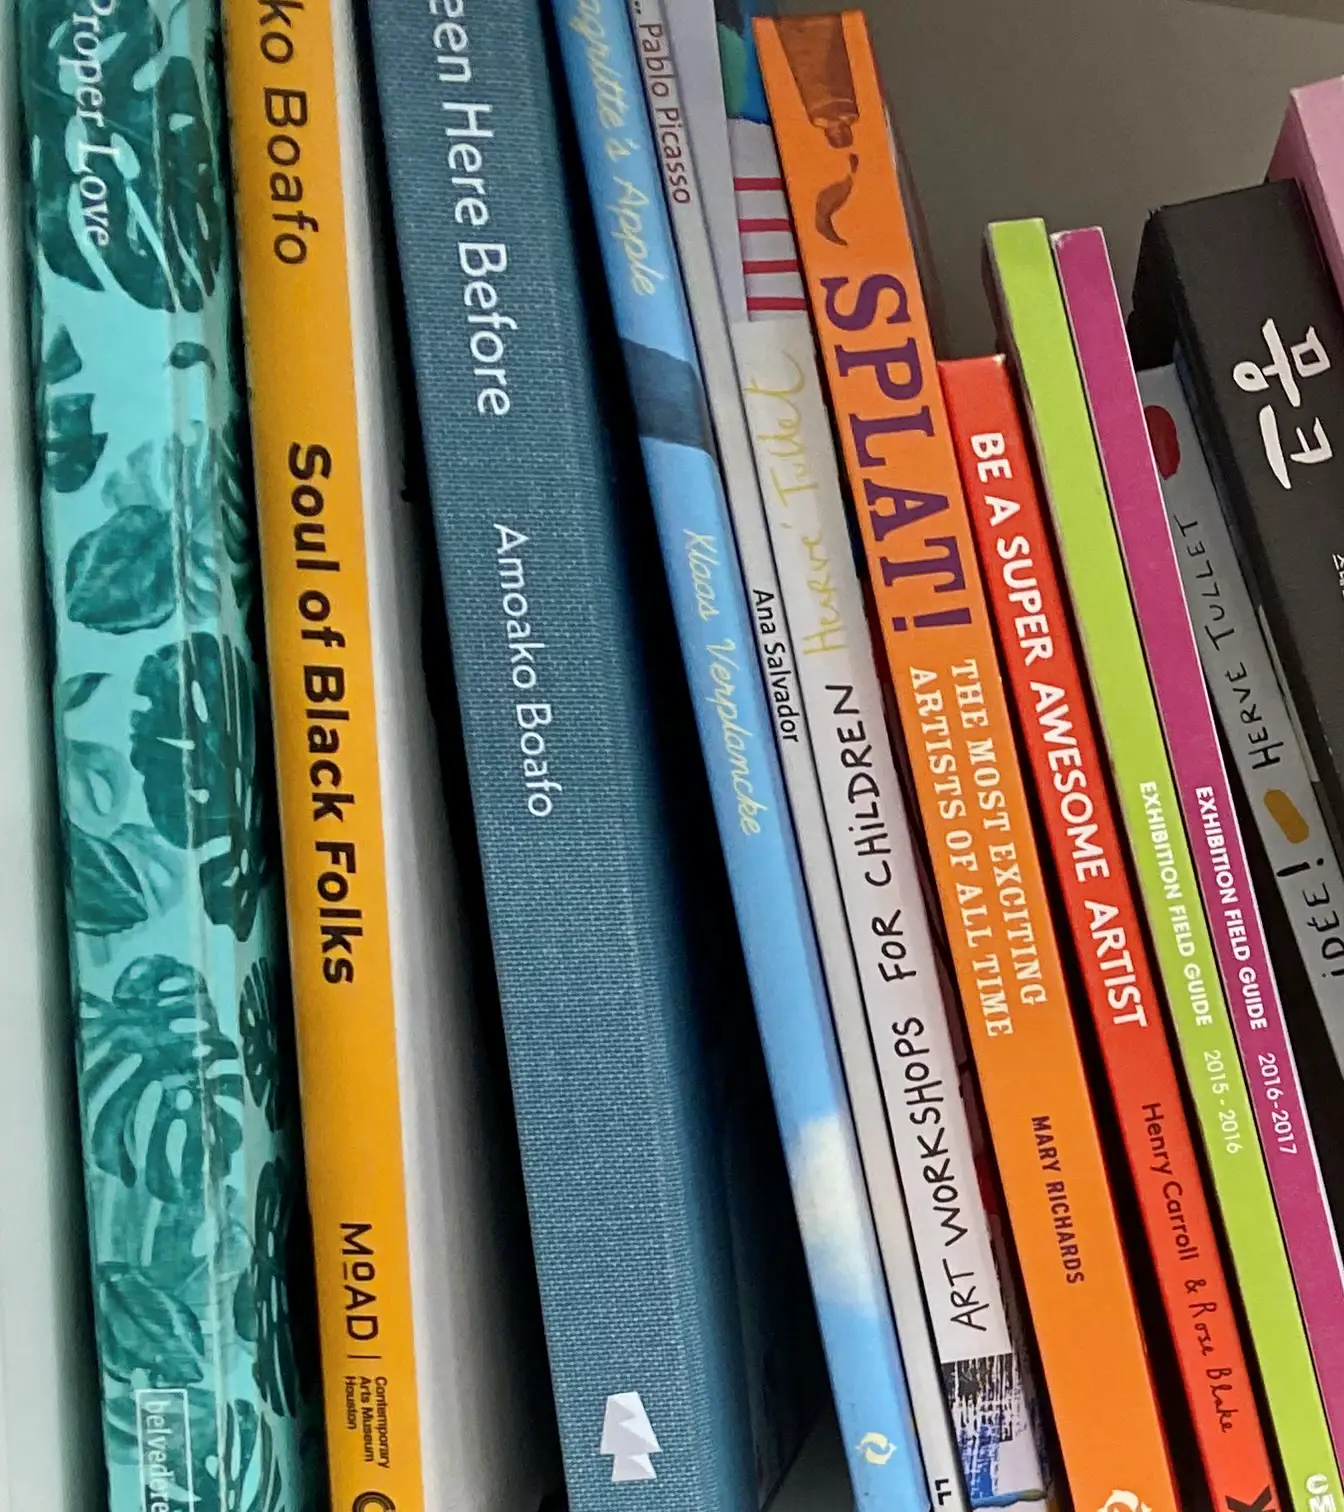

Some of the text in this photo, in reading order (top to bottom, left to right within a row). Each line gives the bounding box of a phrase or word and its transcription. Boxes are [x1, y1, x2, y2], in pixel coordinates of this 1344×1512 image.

[263, 90, 319, 265] Boafo
[639, 22, 690, 205] Pablo Picasso
[441, 101, 518, 419] Here Before
[819, 272, 973, 631] SPLAT!
[1231, 317, 1336, 490] 뭉크
[287, 441, 359, 985] Soul of Black Folks
[752, 587, 799, 743] Ana Salvador
[969, 432, 1148, 1029] BE A SUPER AWESOME ARTIST
[910, 666, 1014, 1037] ARTISTS OF ALL TIME
[951, 659, 1047, 1007] THE MOST EXCITING
[1196, 786, 1268, 1030] EXHIBITION FIELD GUIDE
[869, 909, 919, 985] FOR
[892, 1014, 970, 1244] WORKSHOPS
[1032, 1115, 1085, 1286] MARY RICHARDS
[949, 1248, 987, 1331] ART
[344, 1375, 359, 1430] Houston
[358, 1375, 377, 1463] Arts Museum
[373, 1375, 391, 1469] Contemporary
